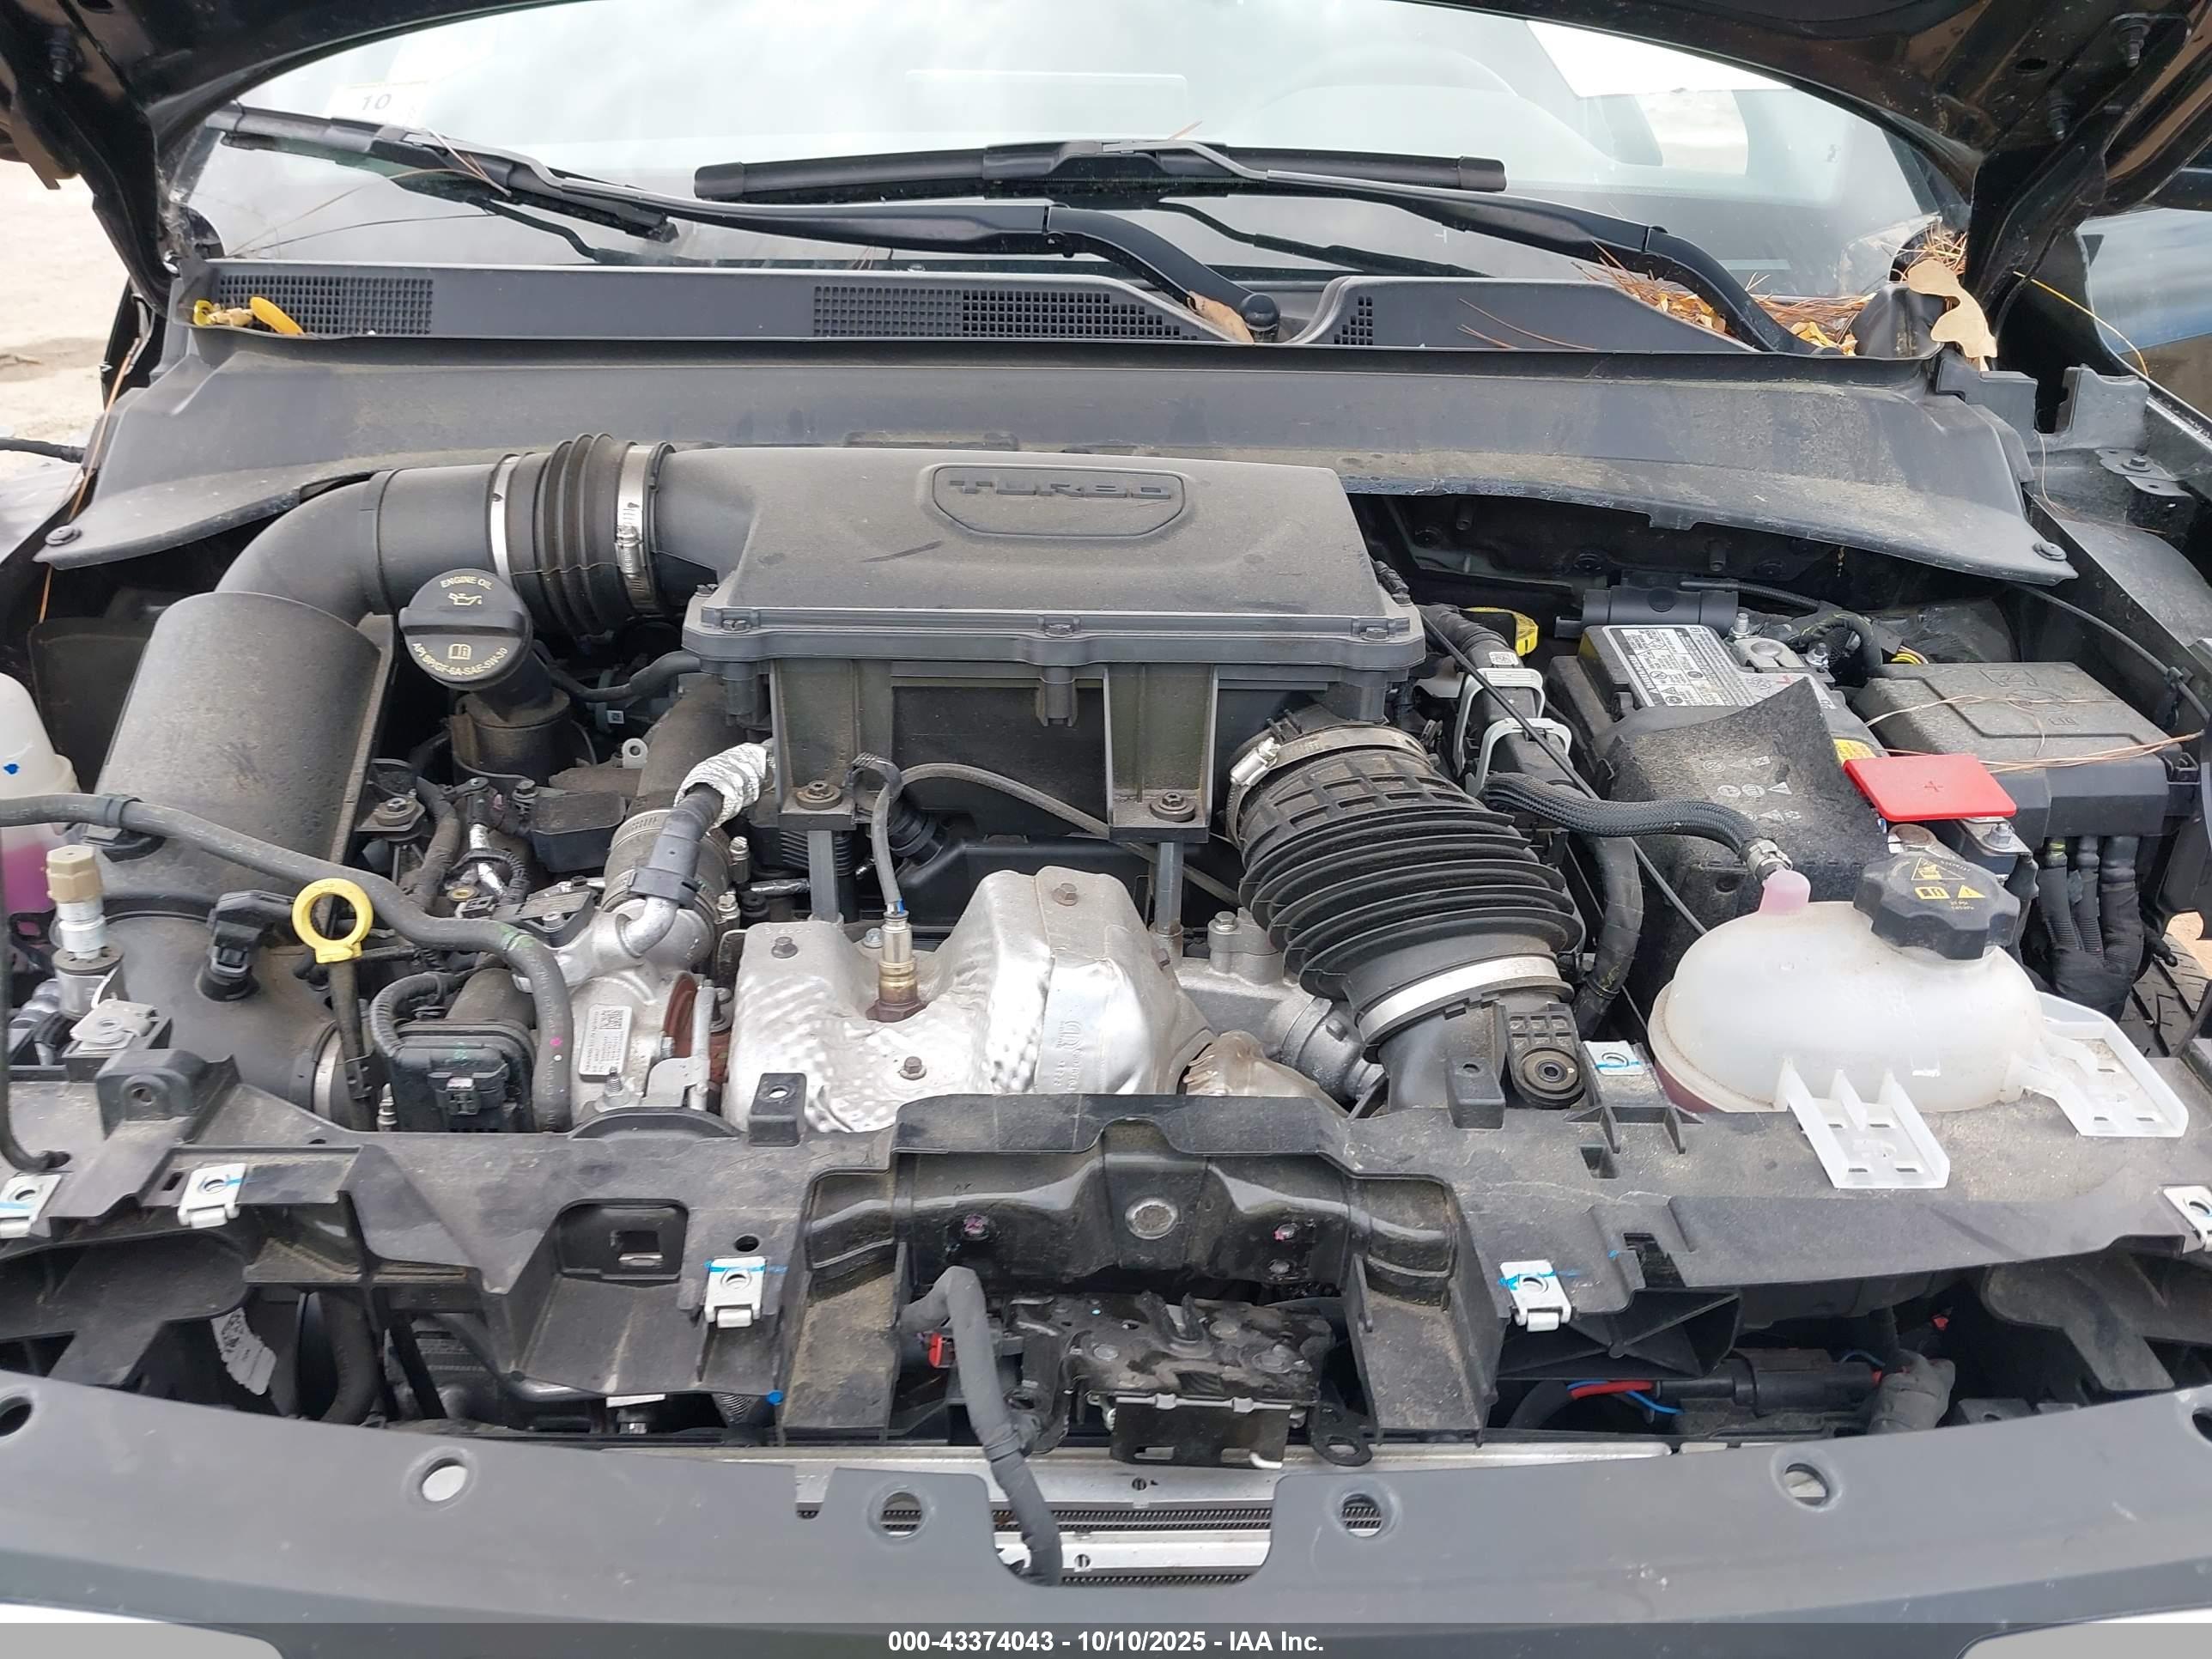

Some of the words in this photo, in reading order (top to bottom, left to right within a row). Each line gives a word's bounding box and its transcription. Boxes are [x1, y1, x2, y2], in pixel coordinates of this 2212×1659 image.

[362, 93, 392, 111] 10
[949, 478, 1173, 500] TURBO
[440, 575, 477, 588] ENGINE
[477, 577, 494, 591] OIL
[412, 642, 427, 657] API
